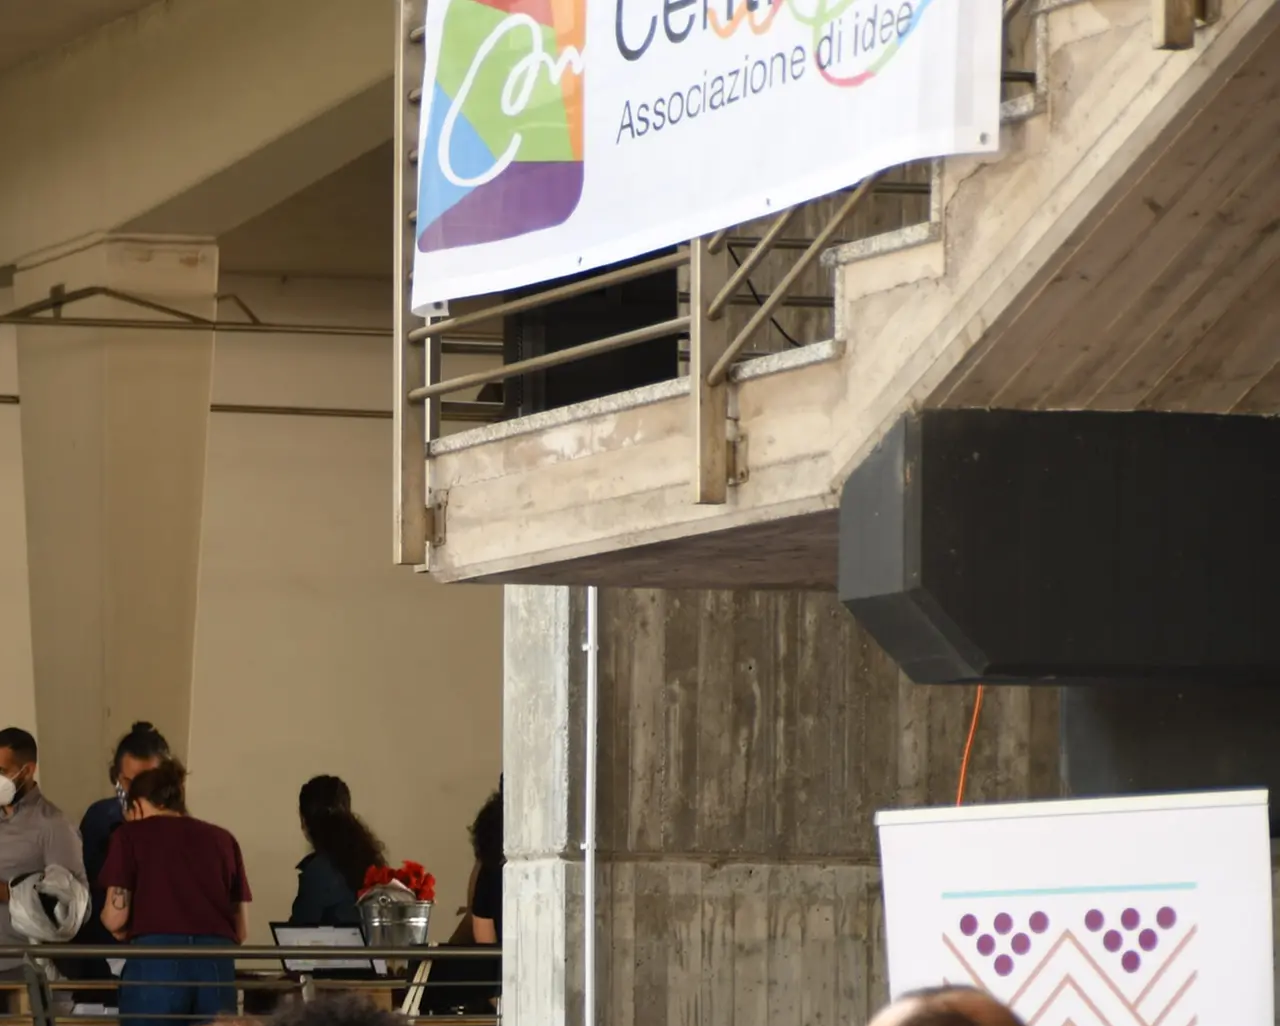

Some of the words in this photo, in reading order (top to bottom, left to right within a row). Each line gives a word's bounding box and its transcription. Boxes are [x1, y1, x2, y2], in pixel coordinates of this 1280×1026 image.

[615, 45, 807, 145] Associazione
[816, 15, 843, 71] di
[852, 1, 915, 58] idee
